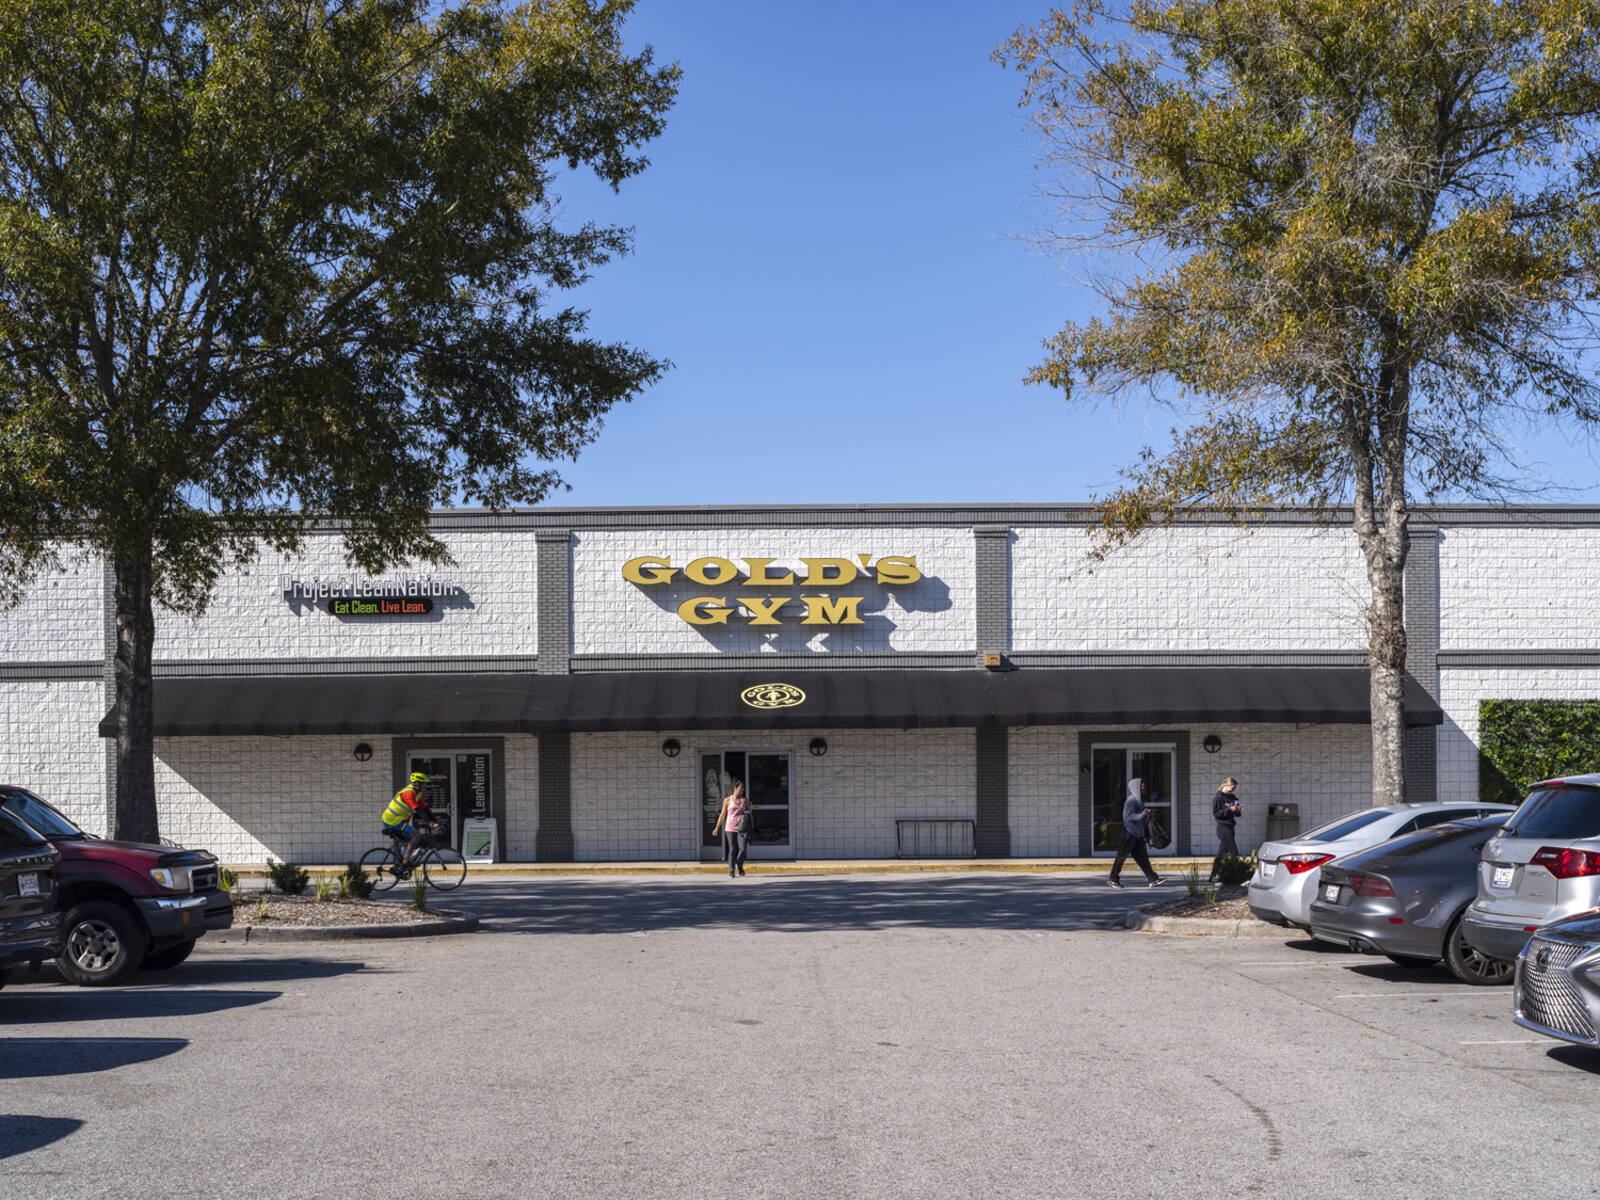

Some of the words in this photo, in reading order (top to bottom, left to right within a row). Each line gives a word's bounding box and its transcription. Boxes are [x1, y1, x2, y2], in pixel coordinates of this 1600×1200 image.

[622, 553, 921, 586] GOLD'S
[280, 573, 348, 603] Project
[335, 600, 350, 614] Eat
[351, 600, 380, 614] Clean.
[381, 600, 400, 613] Live
[402, 599, 426, 613] Lean.
[677, 596, 866, 625] GYM
[471, 756, 485, 812] LeanNation
